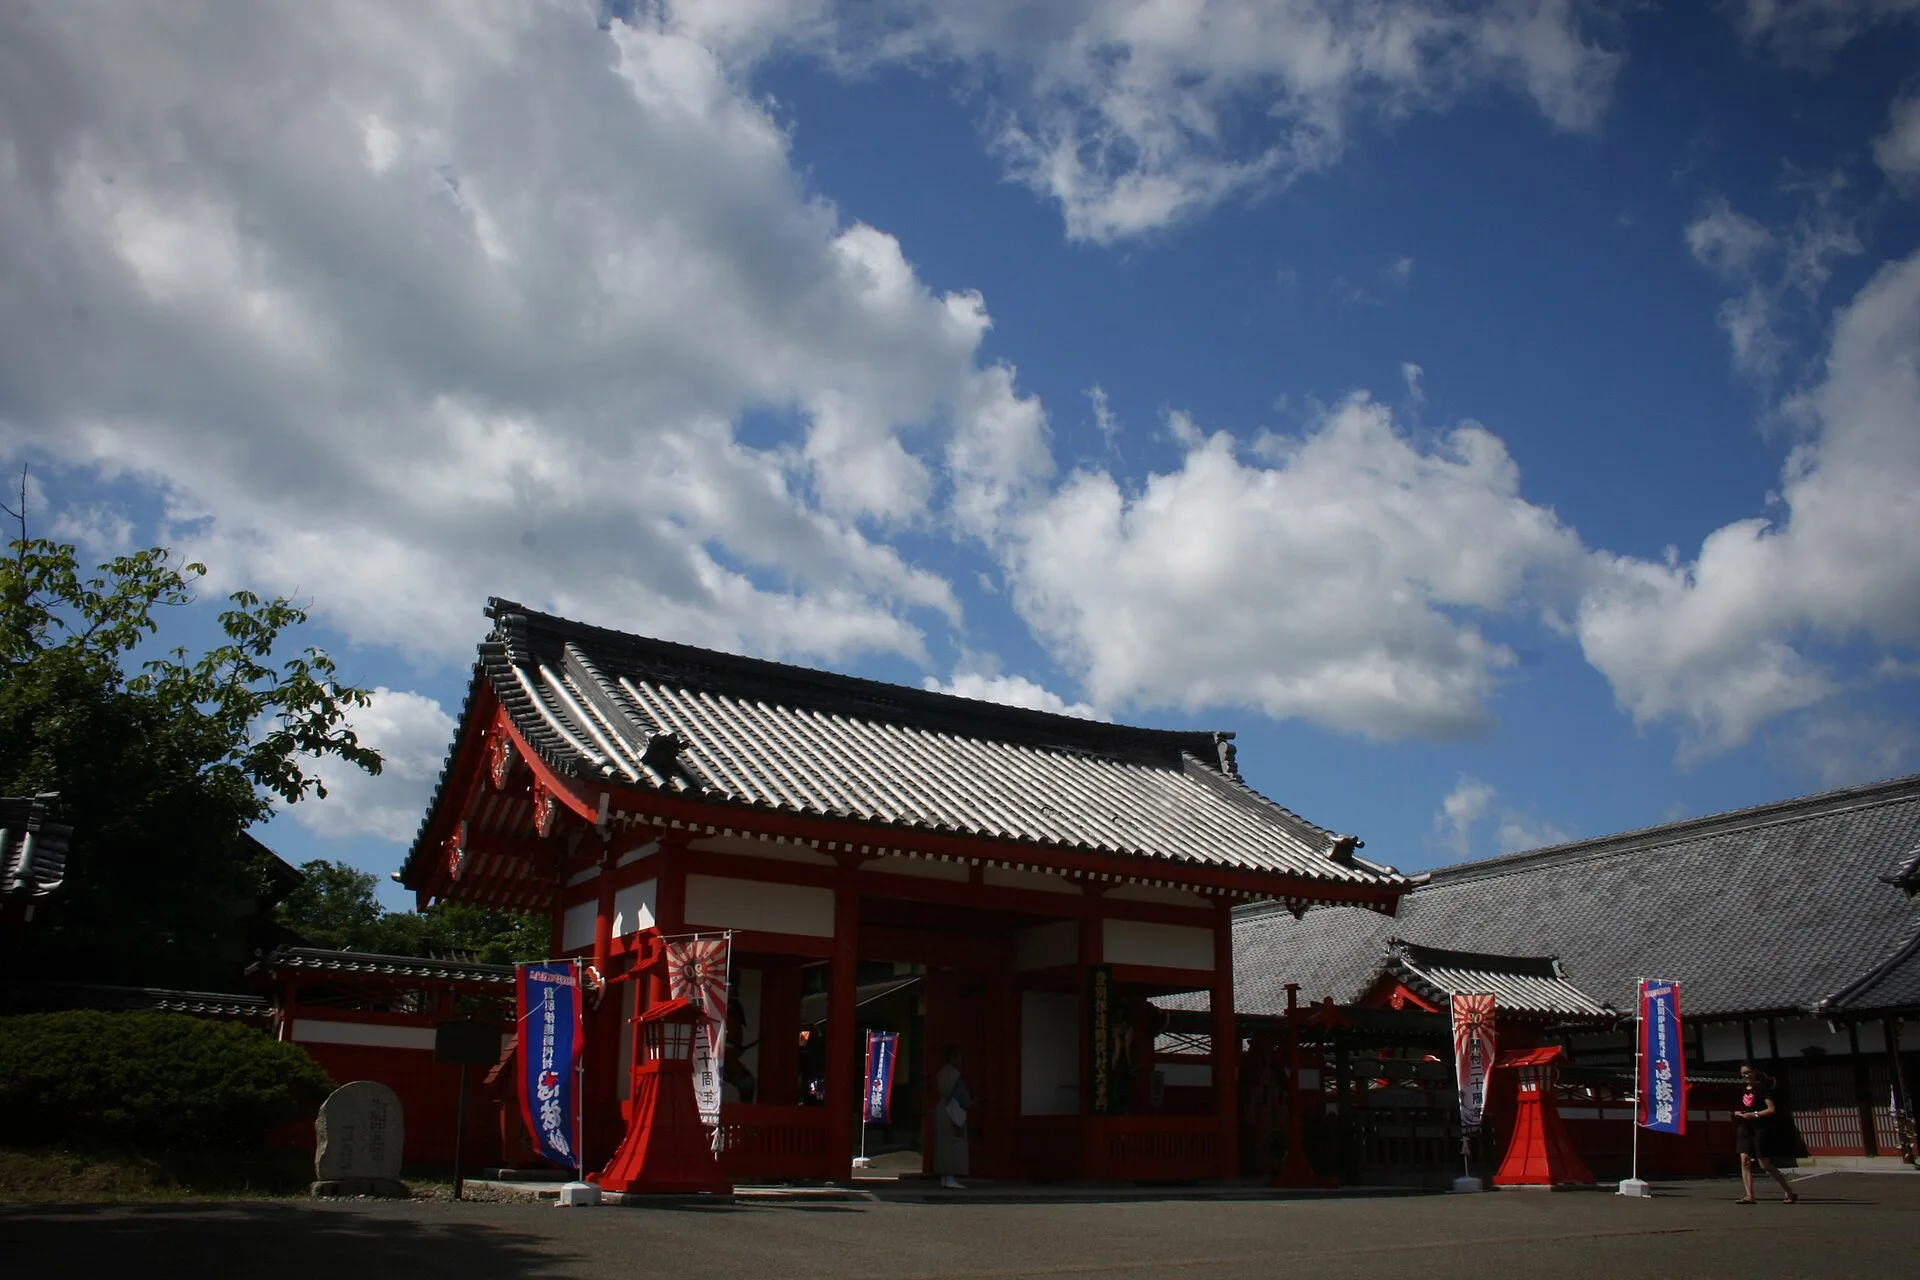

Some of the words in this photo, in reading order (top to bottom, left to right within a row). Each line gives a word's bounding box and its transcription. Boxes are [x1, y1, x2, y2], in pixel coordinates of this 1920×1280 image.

[1467, 1012, 1483, 1024] 20
[1470, 1039, 1484, 1120] 開村二十周年
